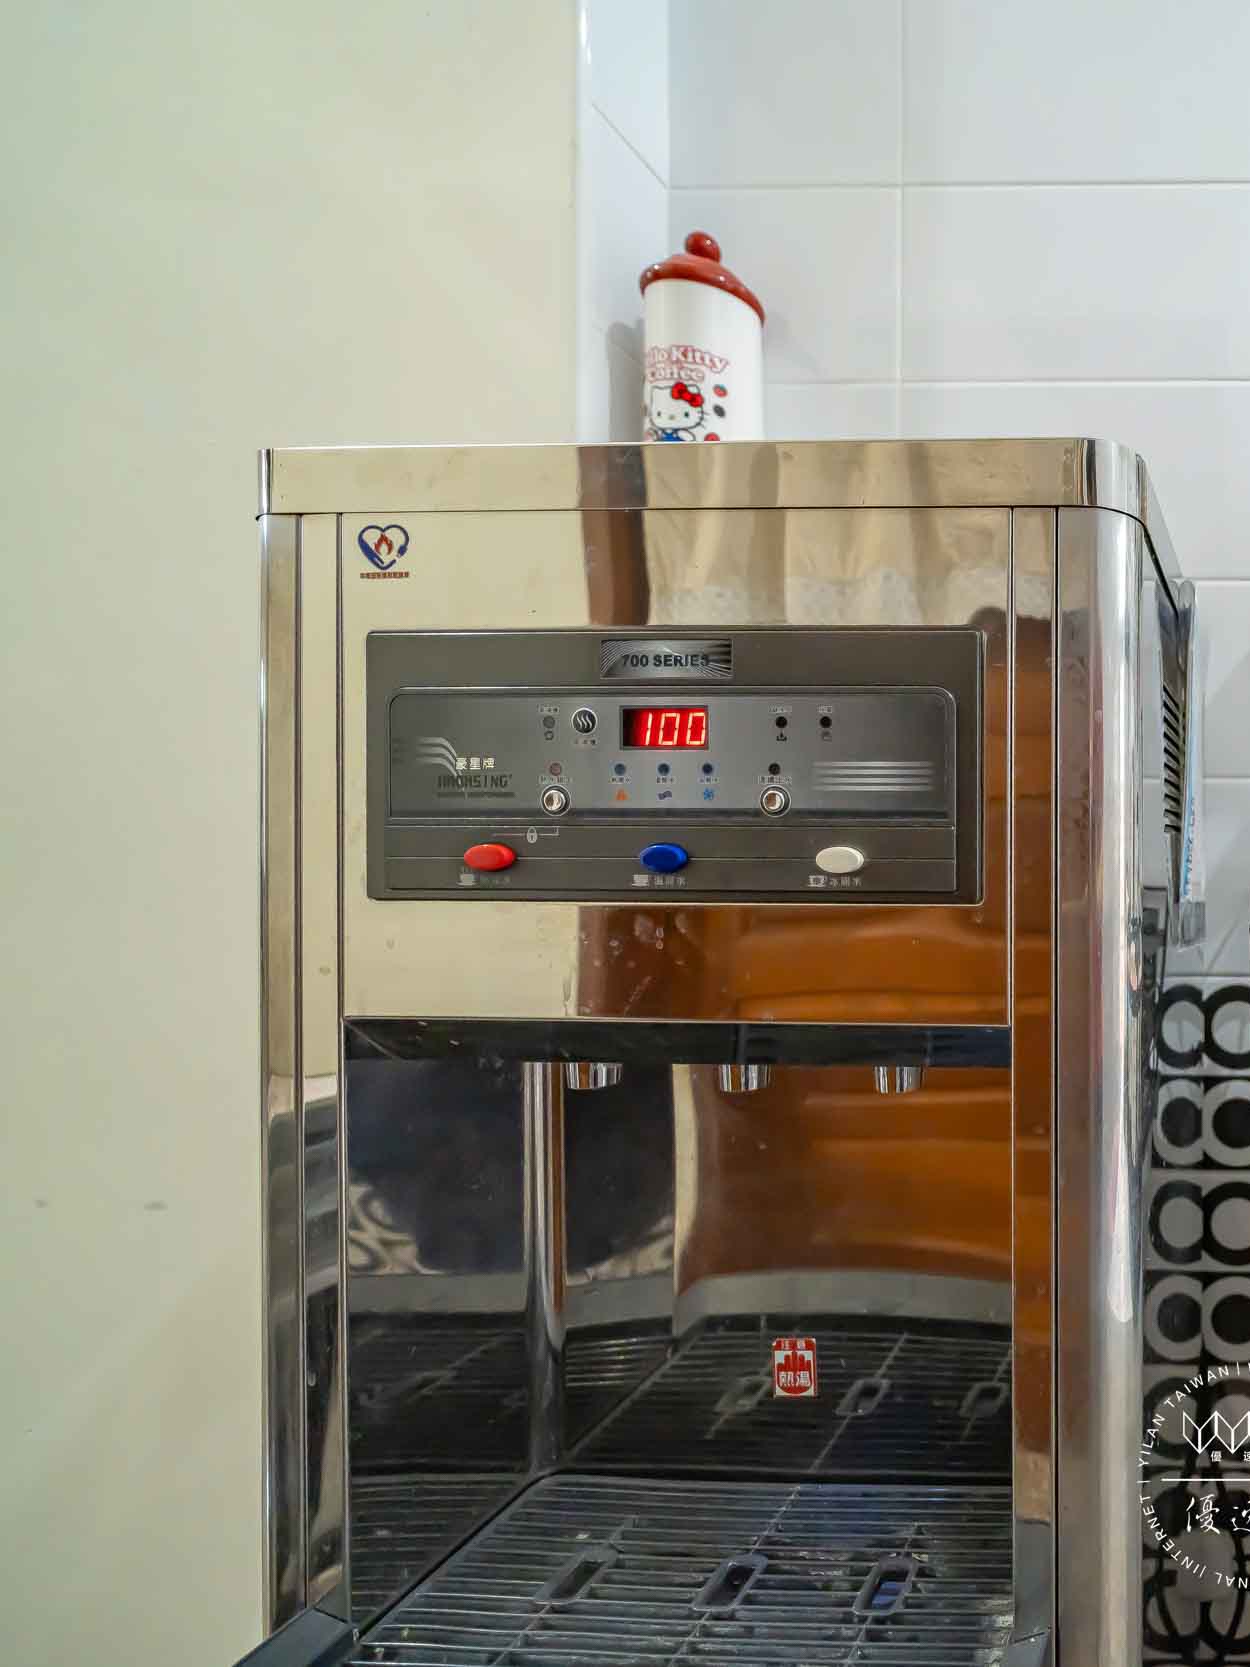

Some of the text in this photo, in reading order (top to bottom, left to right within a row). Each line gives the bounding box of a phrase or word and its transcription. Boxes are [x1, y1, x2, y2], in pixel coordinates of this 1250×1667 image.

[671, 344, 729, 373] Kitty
[622, 654, 710, 668] 700 SERIES
[645, 712, 706, 746] 100
